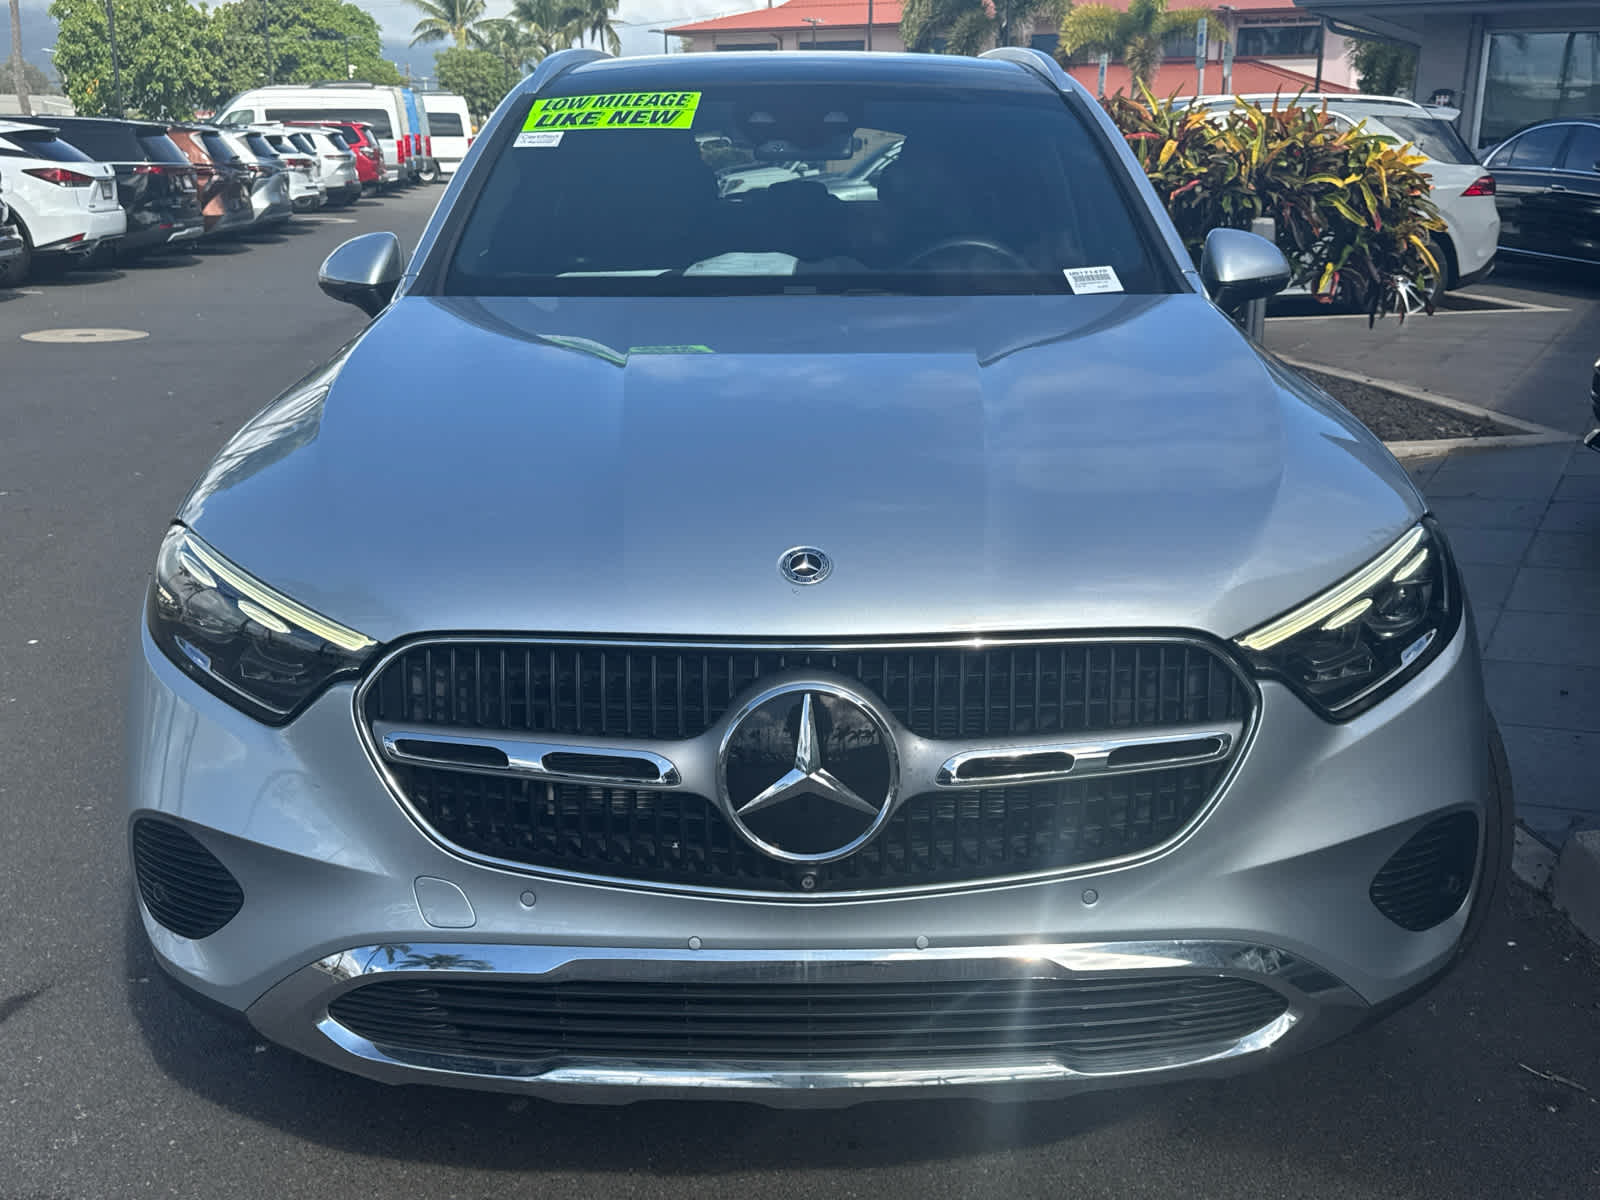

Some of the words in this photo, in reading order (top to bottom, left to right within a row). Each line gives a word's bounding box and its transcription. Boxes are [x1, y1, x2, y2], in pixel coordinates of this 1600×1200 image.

[541, 96, 592, 111] LOW
[592, 94, 691, 107] MILEAGE
[535, 112, 603, 127] LIKE
[607, 110, 682, 125] NEW
